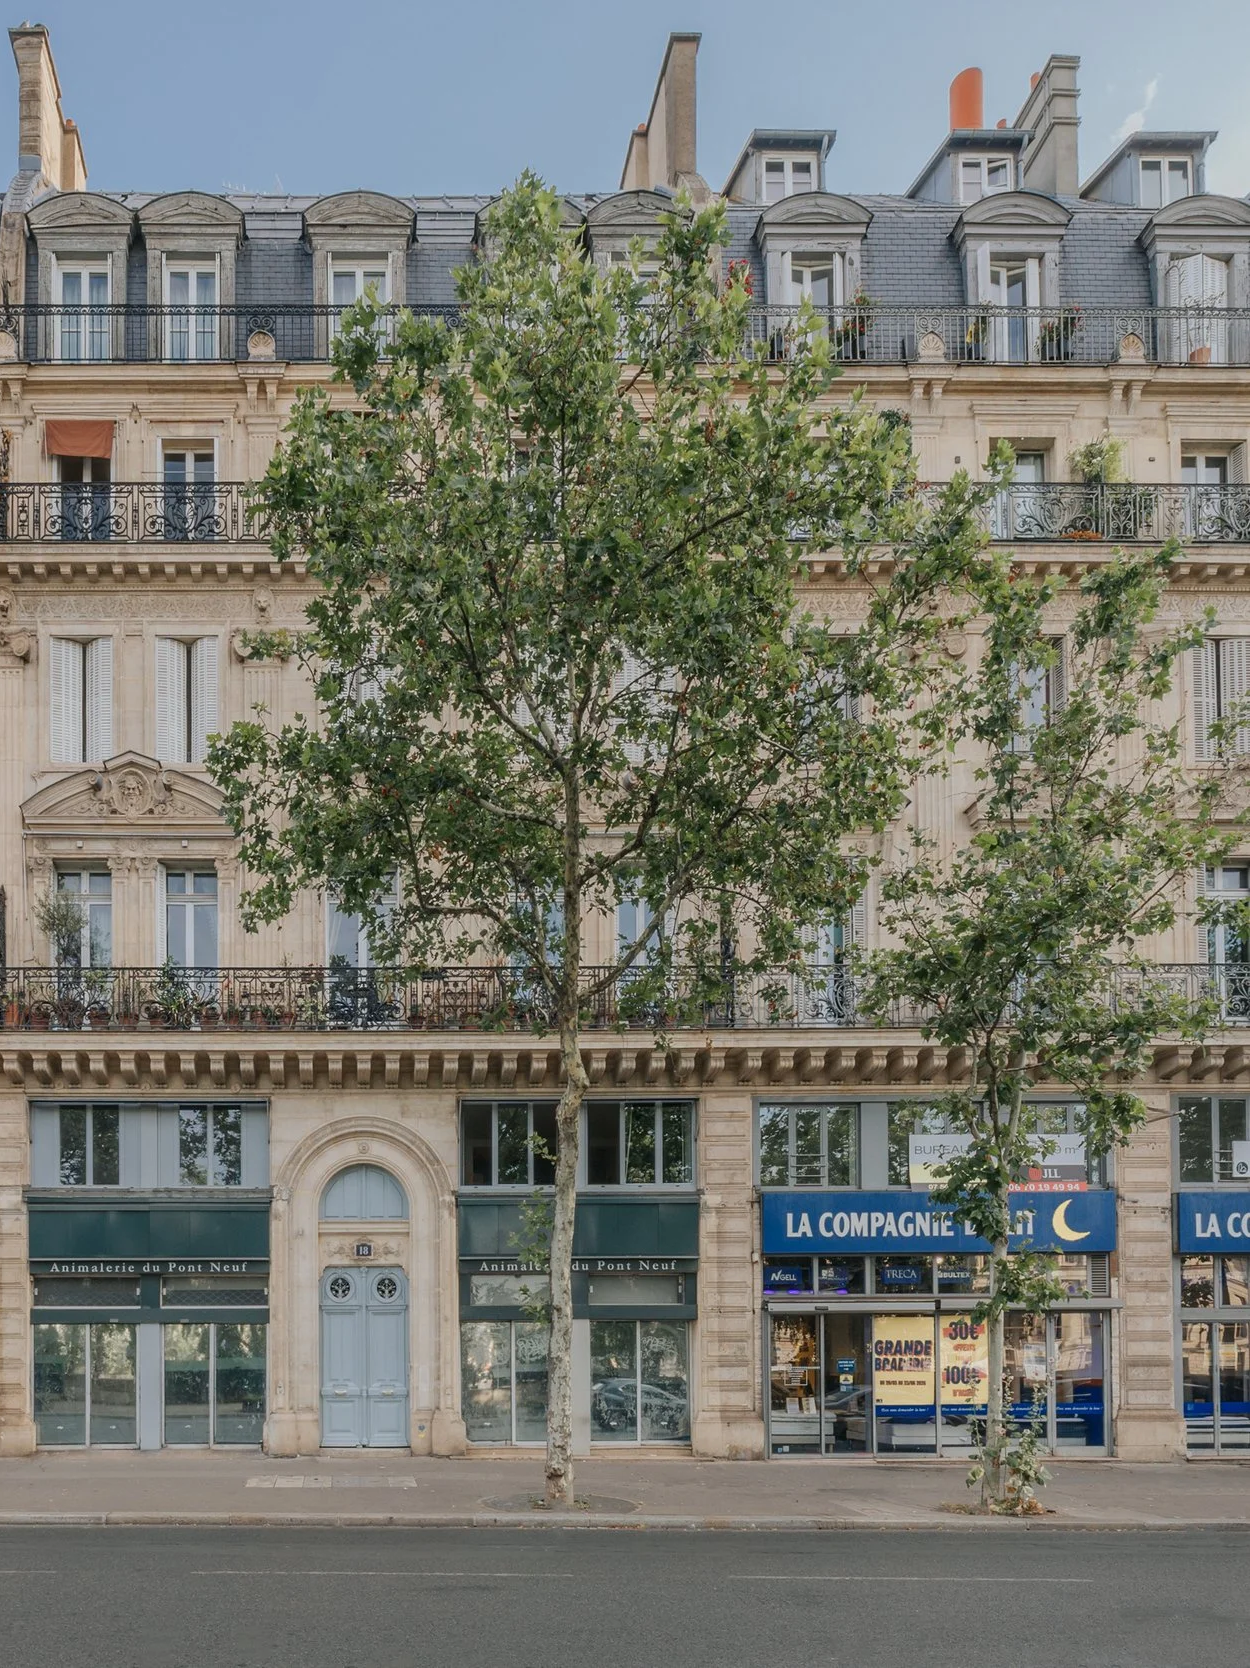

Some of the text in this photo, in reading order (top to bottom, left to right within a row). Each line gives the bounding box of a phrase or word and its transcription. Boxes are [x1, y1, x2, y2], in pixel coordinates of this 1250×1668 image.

[1042, 1168, 1061, 1179] JLL
[1008, 1183, 1021, 1191] 06
[1038, 1183, 1050, 1191] 19
[1052, 1183, 1065, 1191] 49
[1067, 1183, 1080, 1191] 94
[786, 1212, 813, 1238] LA
[819, 1211, 954, 1238] COMPAGNIE
[1195, 1212, 1222, 1238] LA
[359, 1245, 369, 1255] 18
[50, 1261, 248, 1273] Animalerie du Pont Neuf
[479, 1260, 678, 1272] Animale du Pont Neuf
[886, 1269, 917, 1279] TRECA
[949, 1321, 979, 1340] 30€
[874, 1340, 932, 1356] GRANDE
